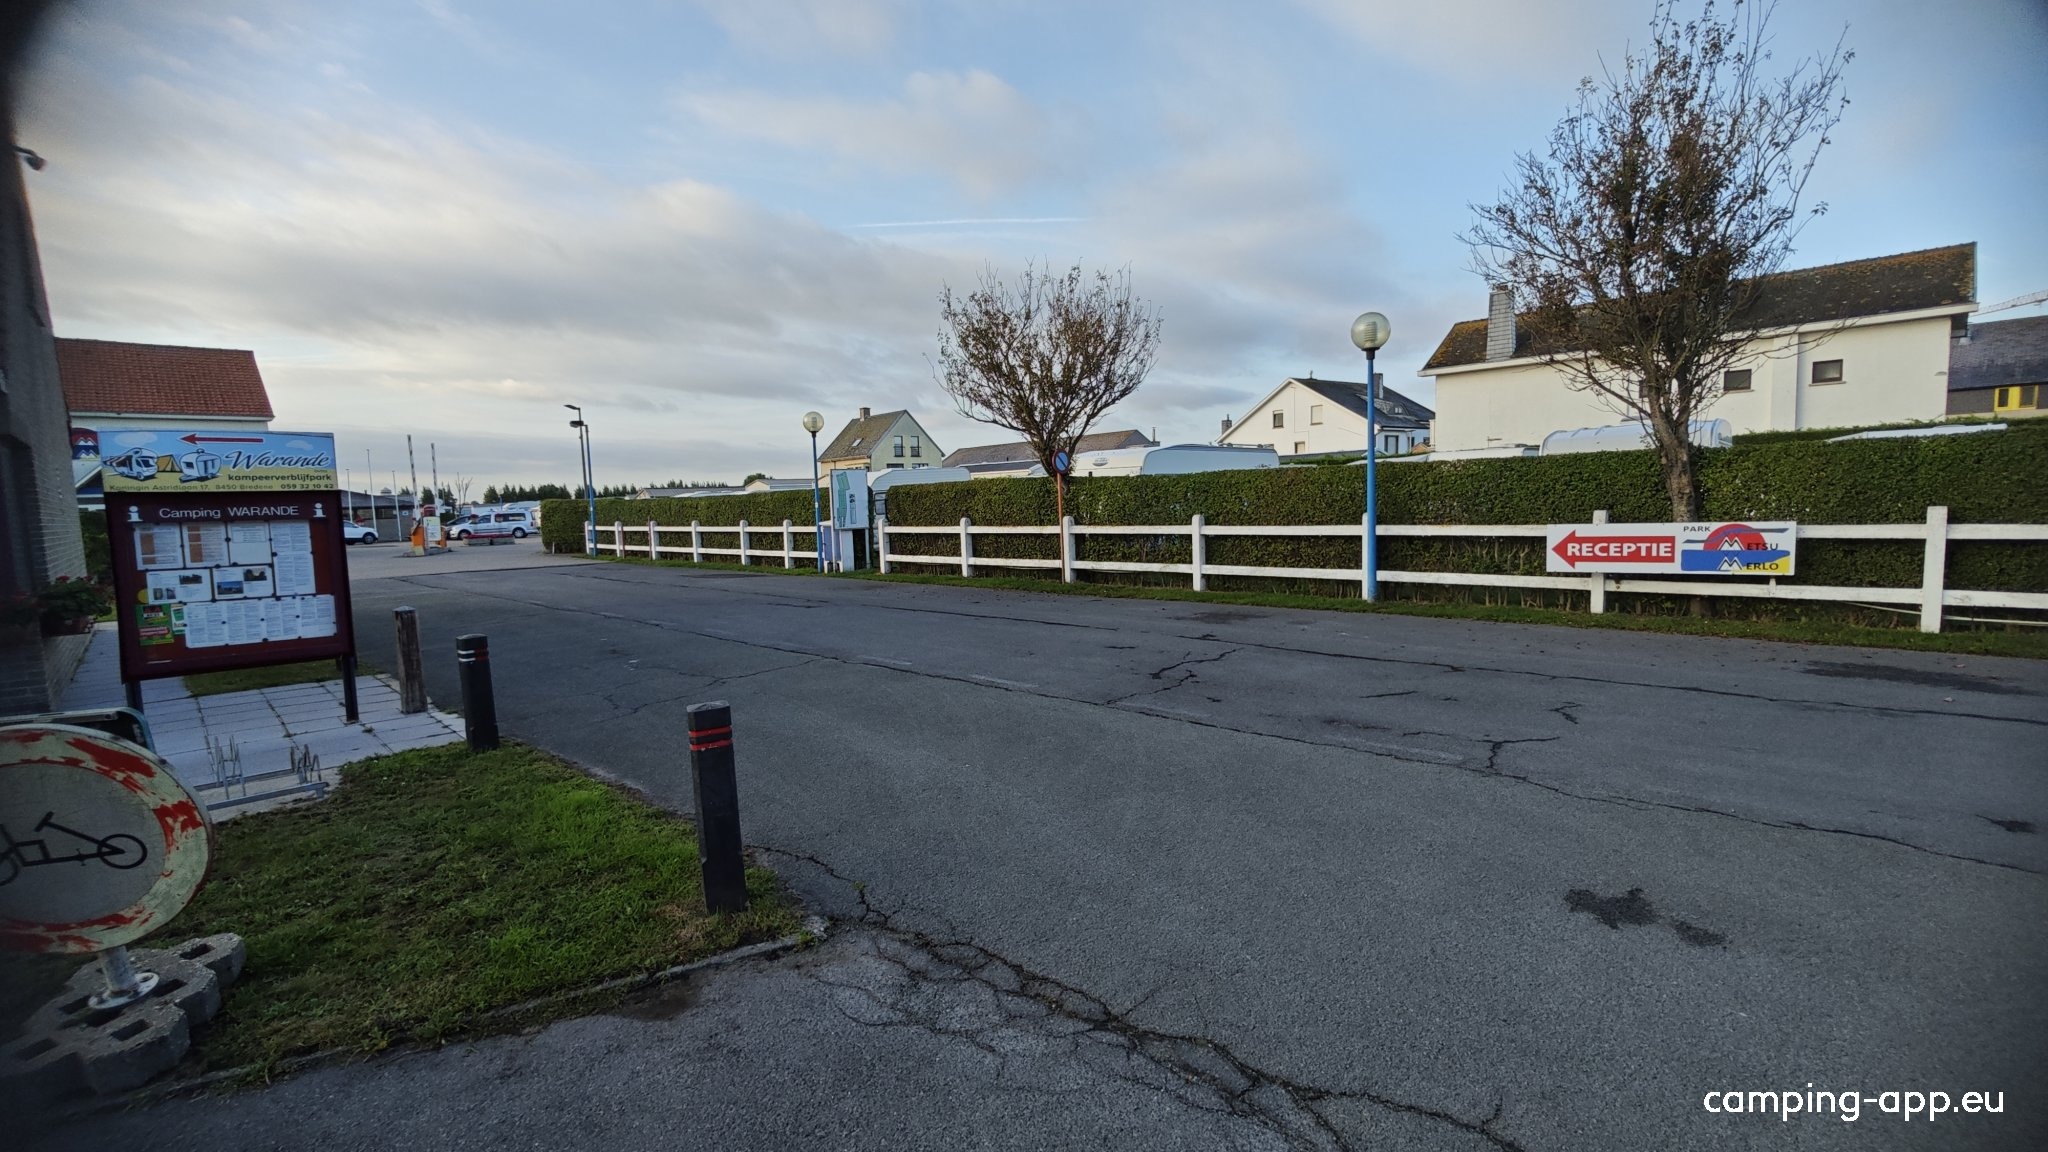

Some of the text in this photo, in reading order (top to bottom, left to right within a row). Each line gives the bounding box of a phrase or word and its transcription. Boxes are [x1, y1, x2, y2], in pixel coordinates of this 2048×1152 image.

[225, 450, 330, 470] Warande
[228, 473, 333, 482] kampeerverblijfpark
[159, 505, 299, 519] Camping WARANDE
[1683, 525, 1711, 533] PARK
[1567, 542, 1672, 557] RECEPTIE
